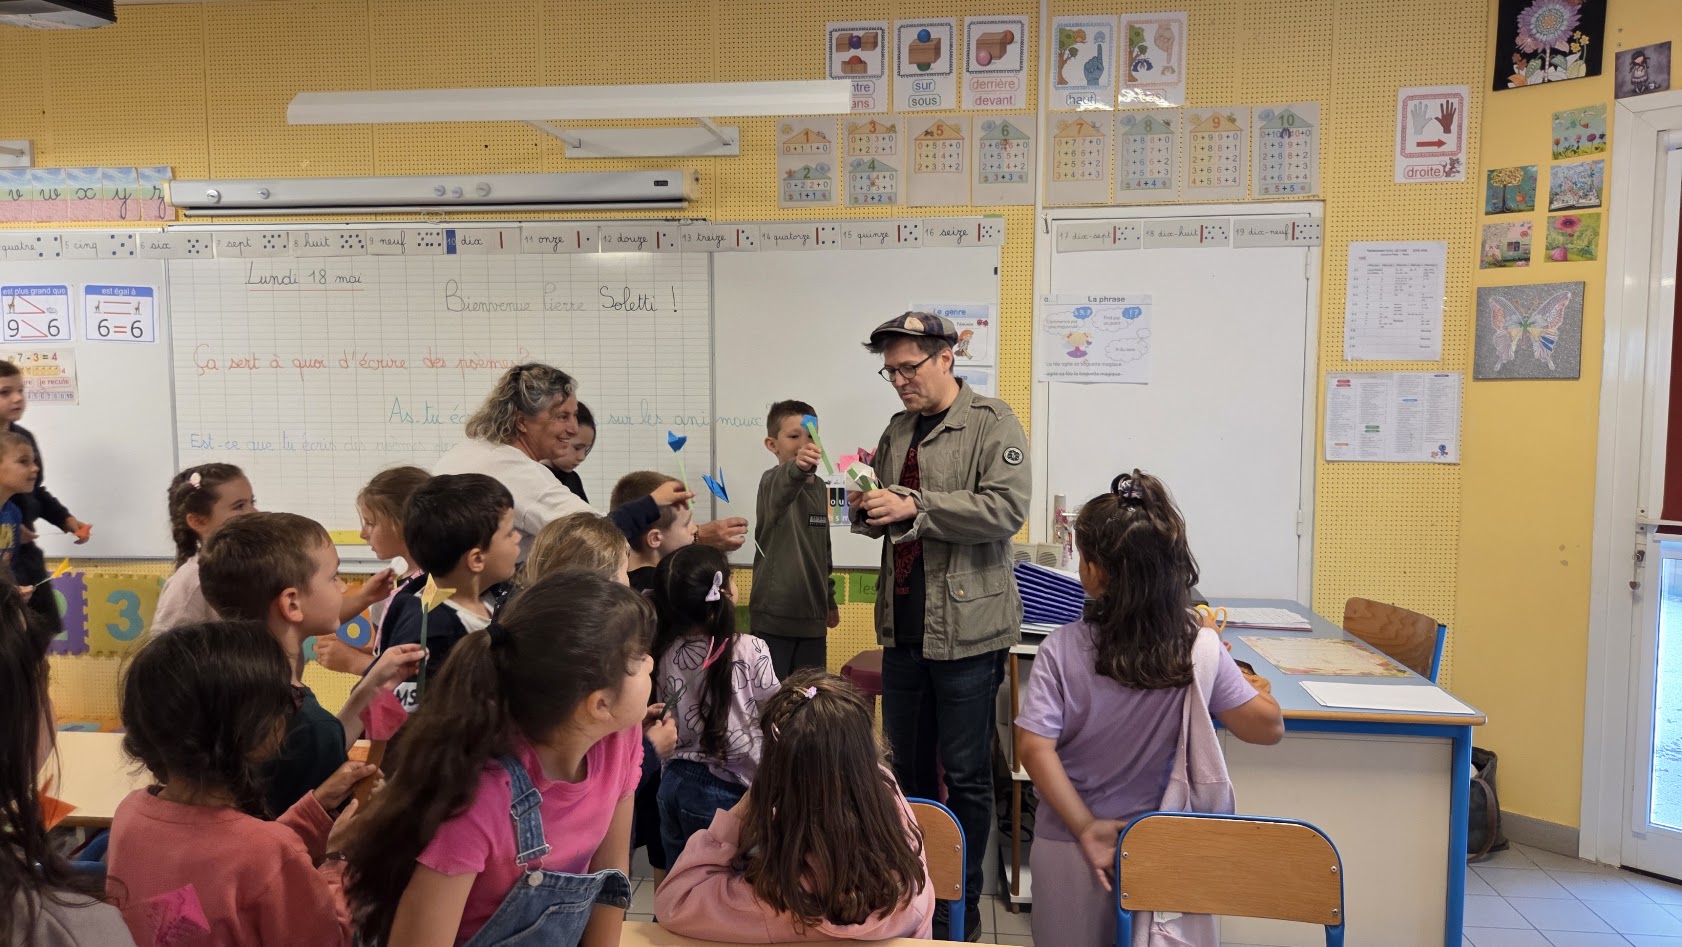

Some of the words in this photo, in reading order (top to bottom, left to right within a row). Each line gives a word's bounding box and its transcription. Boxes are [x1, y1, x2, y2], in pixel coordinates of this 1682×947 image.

[852, 83, 870, 92] ntre
[914, 81, 932, 91] sur
[972, 78, 1016, 90] derrière
[852, 99, 870, 108] ans
[911, 96, 938, 106] sous
[974, 95, 1012, 106] devant
[1144, 120, 1152, 132] 8
[1212, 116, 1220, 128] 9
[1279, 114, 1295, 127] 10
[869, 122, 876, 134] 3
[936, 125, 944, 136] 5
[1002, 125, 1009, 136] 6
[1076, 123, 1083, 134] 7
[804, 132, 810, 144] 1
[868, 160, 876, 171] 4
[803, 167, 810, 179] 2
[1406, 166, 1440, 178] droite
[8, 189, 23, 201] v
[40, 188, 62, 201] w
[75, 187, 97, 200] x
[112, 188, 132, 220] y
[150, 186, 166, 220] z
[843, 231, 852, 240] 15
[857, 230, 890, 246] quinze
[924, 228, 933, 237] 16
[940, 228, 968, 242] seize
[1072, 230, 1111, 246] dix-sept
[1158, 226, 1198, 238] dix-huit
[1235, 228, 1244, 236] 19
[1249, 224, 1289, 241] dix-neuf
[150, 240, 171, 250] six
[304, 233, 330, 248] huit
[379, 230, 407, 254] neuf
[447, 238, 456, 246] 10
[460, 234, 483, 246] dix
[538, 236, 565, 252] onze
[617, 232, 648, 251] douze
[682, 233, 691, 242] 13
[695, 232, 726, 248] treize
[762, 233, 771, 242] 14
[773, 232, 811, 246] quatorze
[2, 242, 36, 256] quatre
[73, 240, 98, 259] cinq
[226, 237, 252, 257] sept
[246, 262, 298, 286] Lundi
[308, 270, 327, 284] 18
[335, 273, 362, 284] mai
[15, 288, 29, 297] plus
[30, 287, 51, 296] grand
[52, 288, 66, 296] que
[114, 287, 129, 296] égal
[131, 287, 136, 295] à
[446, 279, 532, 312] Bienvenue
[542, 282, 586, 312] Pierre
[600, 286, 658, 312] Soletti
[945, 309, 966, 317] genre
[8, 319, 19, 338] 9
[48, 318, 60, 337] 6
[98, 318, 110, 337] 6
[131, 320, 144, 338] 6
[18, 353, 23, 362] 7
[34, 353, 39, 362] 3
[52, 352, 58, 361] 4
[193, 344, 219, 376] Ça
[228, 352, 260, 370] sert
[270, 352, 284, 370] à
[293, 358, 326, 382] quoi
[339, 350, 408, 370] d'écrire
[423, 346, 446, 370] des
[608, 413, 634, 426] sur
[642, 398, 663, 426] les
[190, 433, 240, 450] Est-ce
[283, 430, 294, 450] tu
[302, 432, 336, 452] écris
[106, 590, 144, 640] 3
